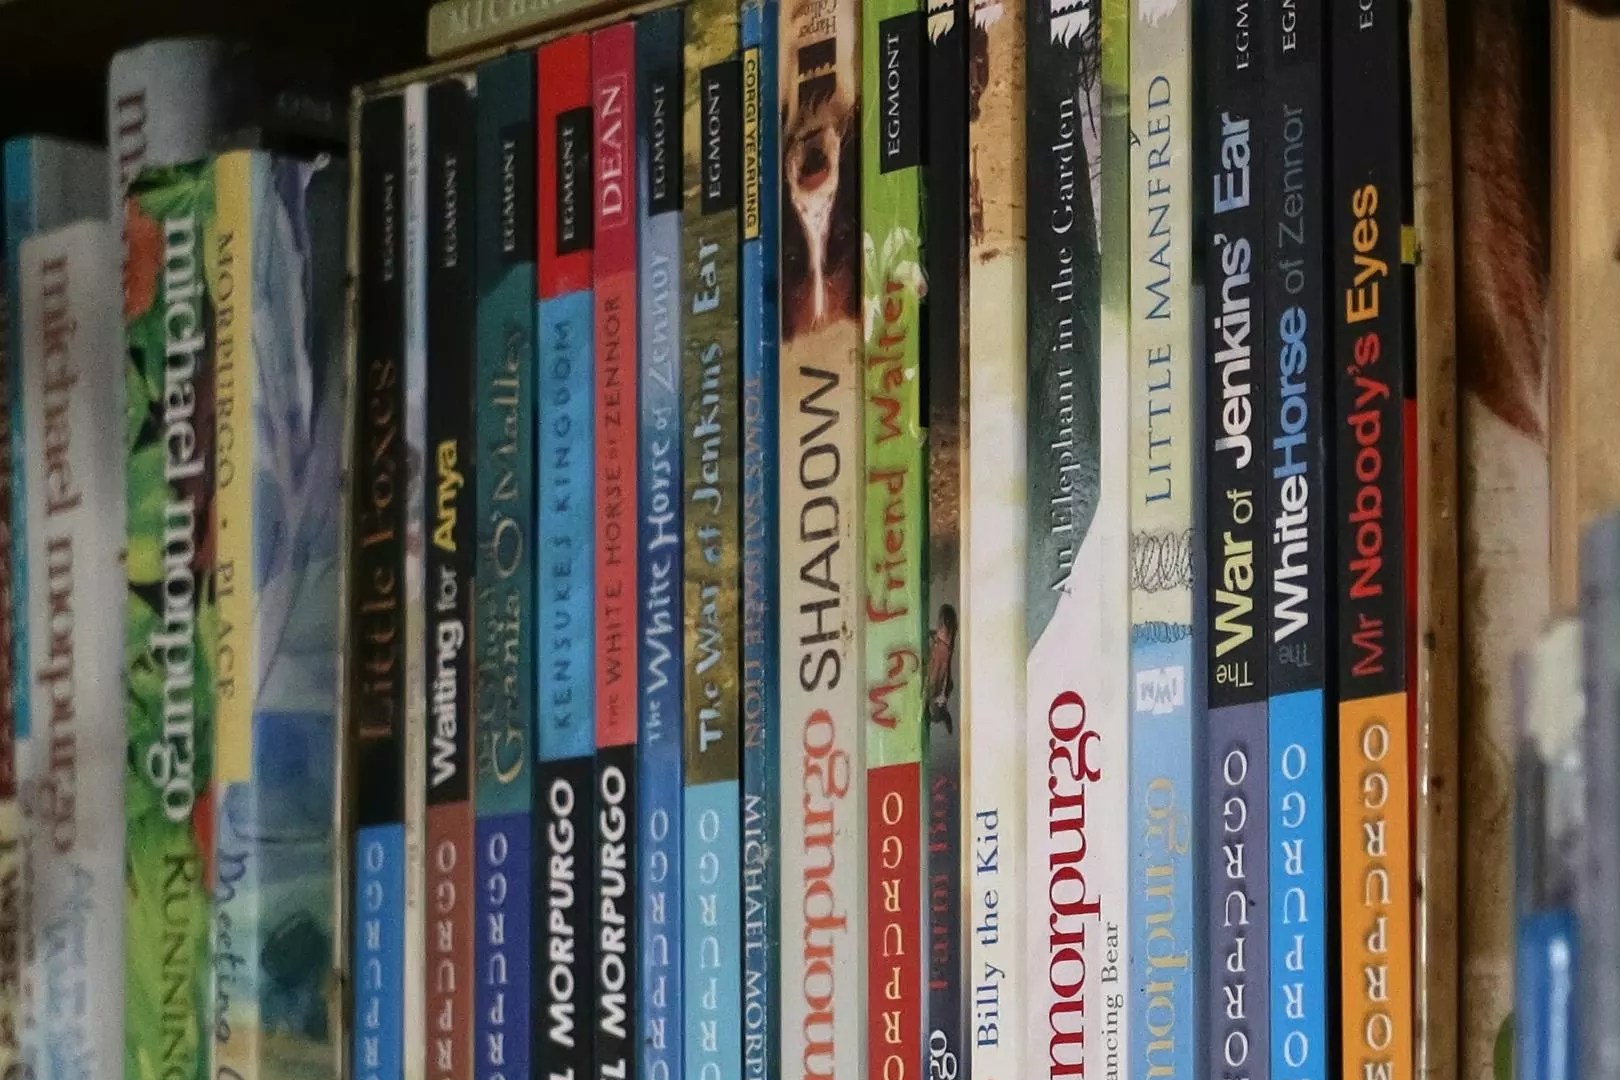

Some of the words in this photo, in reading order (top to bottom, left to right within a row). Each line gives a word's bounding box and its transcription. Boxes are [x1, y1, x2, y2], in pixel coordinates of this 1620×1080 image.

[652, 83, 667, 201] EGMONT
[708, 80, 722, 200] EGMONT
[743, 57, 756, 118] CORGI
[886, 32, 901, 158] EGMONT
[502, 139, 516, 253] EGMONT
[561, 126, 576, 243] EGMONT
[600, 83, 625, 218] DEAN
[743, 122, 757, 231] YEARLING
[1050, 97, 1075, 235] Garden
[1145, 75, 1172, 322] MANFRED
[1213, 110, 1252, 216] Ear
[1277, 102, 1306, 248] Zennor
[691, 236, 722, 316] Ear
[1051, 250, 1074, 302] the
[1279, 259, 1306, 296] of
[1345, 182, 1389, 325] Eyes
[163, 213, 206, 481] michael
[215, 231, 235, 490] MORPURGO
[603, 294, 622, 427] ZENNOR
[649, 250, 678, 394] Zennor
[868, 281, 908, 445] Walter
[1052, 317, 1074, 353] in
[1213, 233, 1253, 470] Jenkins'
[40, 255, 82, 517] michael
[553, 320, 573, 513] KINGDOM
[653, 404, 672, 430] of
[1145, 343, 1172, 505] LITTLE
[361, 359, 396, 549] Foxes
[432, 437, 465, 552] Anya
[647, 435, 679, 552] Horse
[1051, 367, 1082, 534] Elephant
[1226, 488, 1254, 524] of
[1346, 330, 1391, 600] Nobody's
[604, 463, 623, 567] HORSE
[698, 525, 722, 566] of
[743, 494, 764, 644] SAUSAGE
[799, 366, 842, 693] SHADOW
[866, 465, 909, 623] Friend
[1050, 548, 1074, 595] An
[438, 563, 459, 612] for
[604, 588, 624, 686] WHITE
[645, 560, 676, 693] White
[694, 584, 722, 674] War
[1214, 530, 1255, 658] War
[1350, 613, 1385, 679] Mr
[29, 536, 75, 854] morpurgo
[145, 500, 196, 822] morpurgo
[359, 566, 396, 742] Little
[432, 618, 465, 787] Waiting
[743, 662, 764, 750] LION
[867, 644, 919, 730] My
[1215, 659, 1255, 688] The
[646, 700, 662, 748] The
[698, 681, 723, 753] The
[744, 792, 764, 954] MICHAEL
[975, 807, 999, 877] Kid
[547, 777, 577, 1049] MORPURGO
[600, 764, 628, 1041] MORPURGO
[975, 889, 999, 948] the
[1101, 921, 1120, 985] Bear
[976, 961, 1006, 1050] Billy
